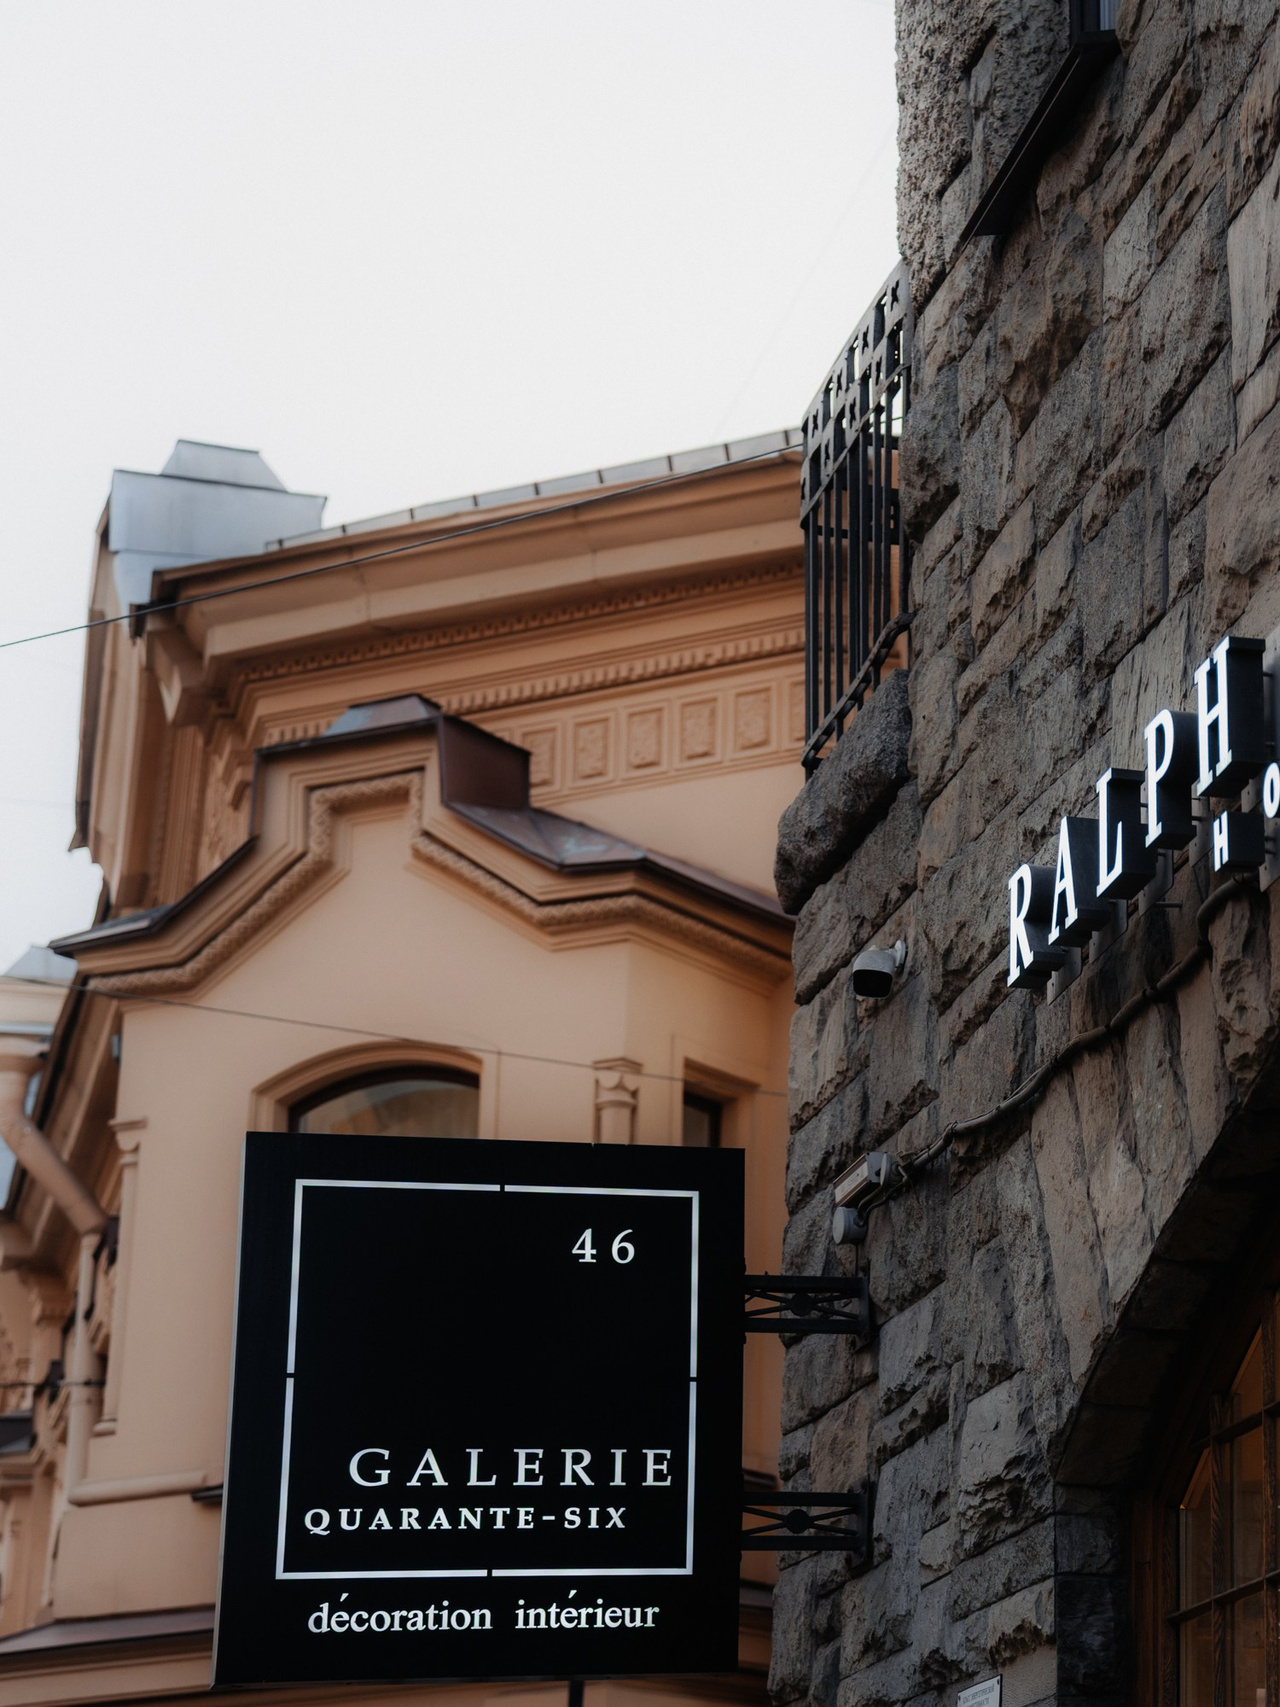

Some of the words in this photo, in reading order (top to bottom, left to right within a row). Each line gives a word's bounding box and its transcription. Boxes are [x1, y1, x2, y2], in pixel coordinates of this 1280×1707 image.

[1007, 636, 1232, 987] RALPH
[571, 1228, 635, 1264] 46
[349, 1448, 673, 1487] GALERIE
[304, 1507, 627, 1535] QUARANTE-SIX
[307, 1593, 493, 1633] décoration
[514, 1590, 660, 1628] intérieur
